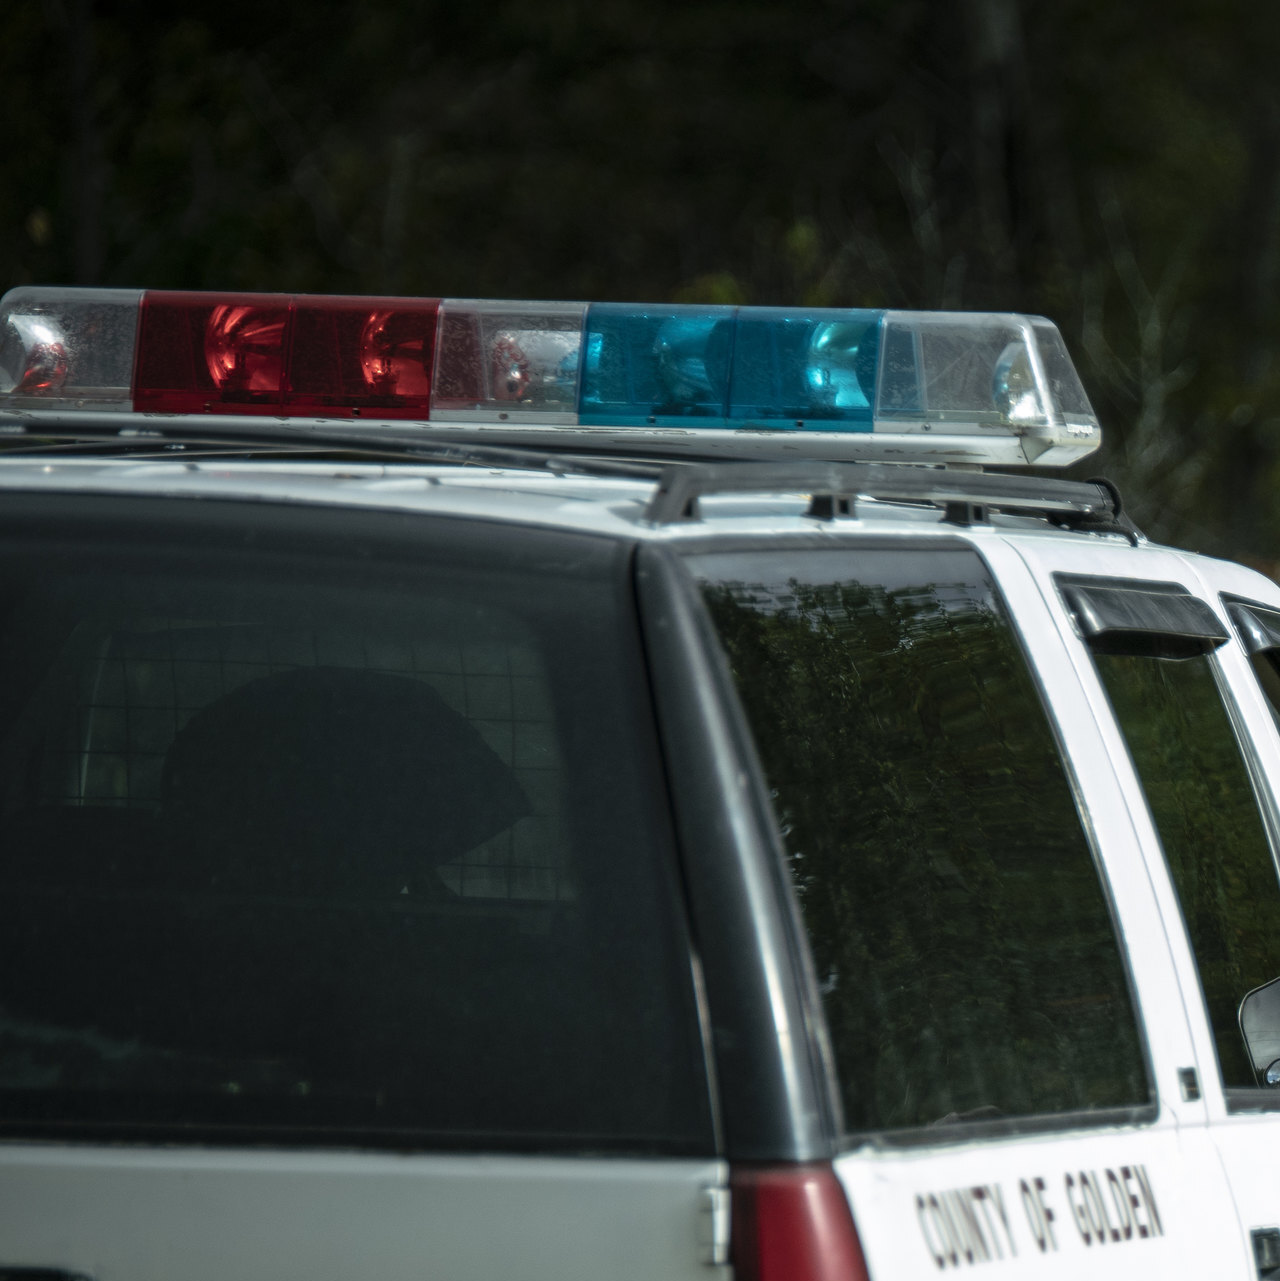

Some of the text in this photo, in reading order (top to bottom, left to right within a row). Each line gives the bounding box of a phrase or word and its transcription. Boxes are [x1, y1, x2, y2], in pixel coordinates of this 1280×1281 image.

[914, 1164, 1165, 1271] COUNTY OF GOLDEN
